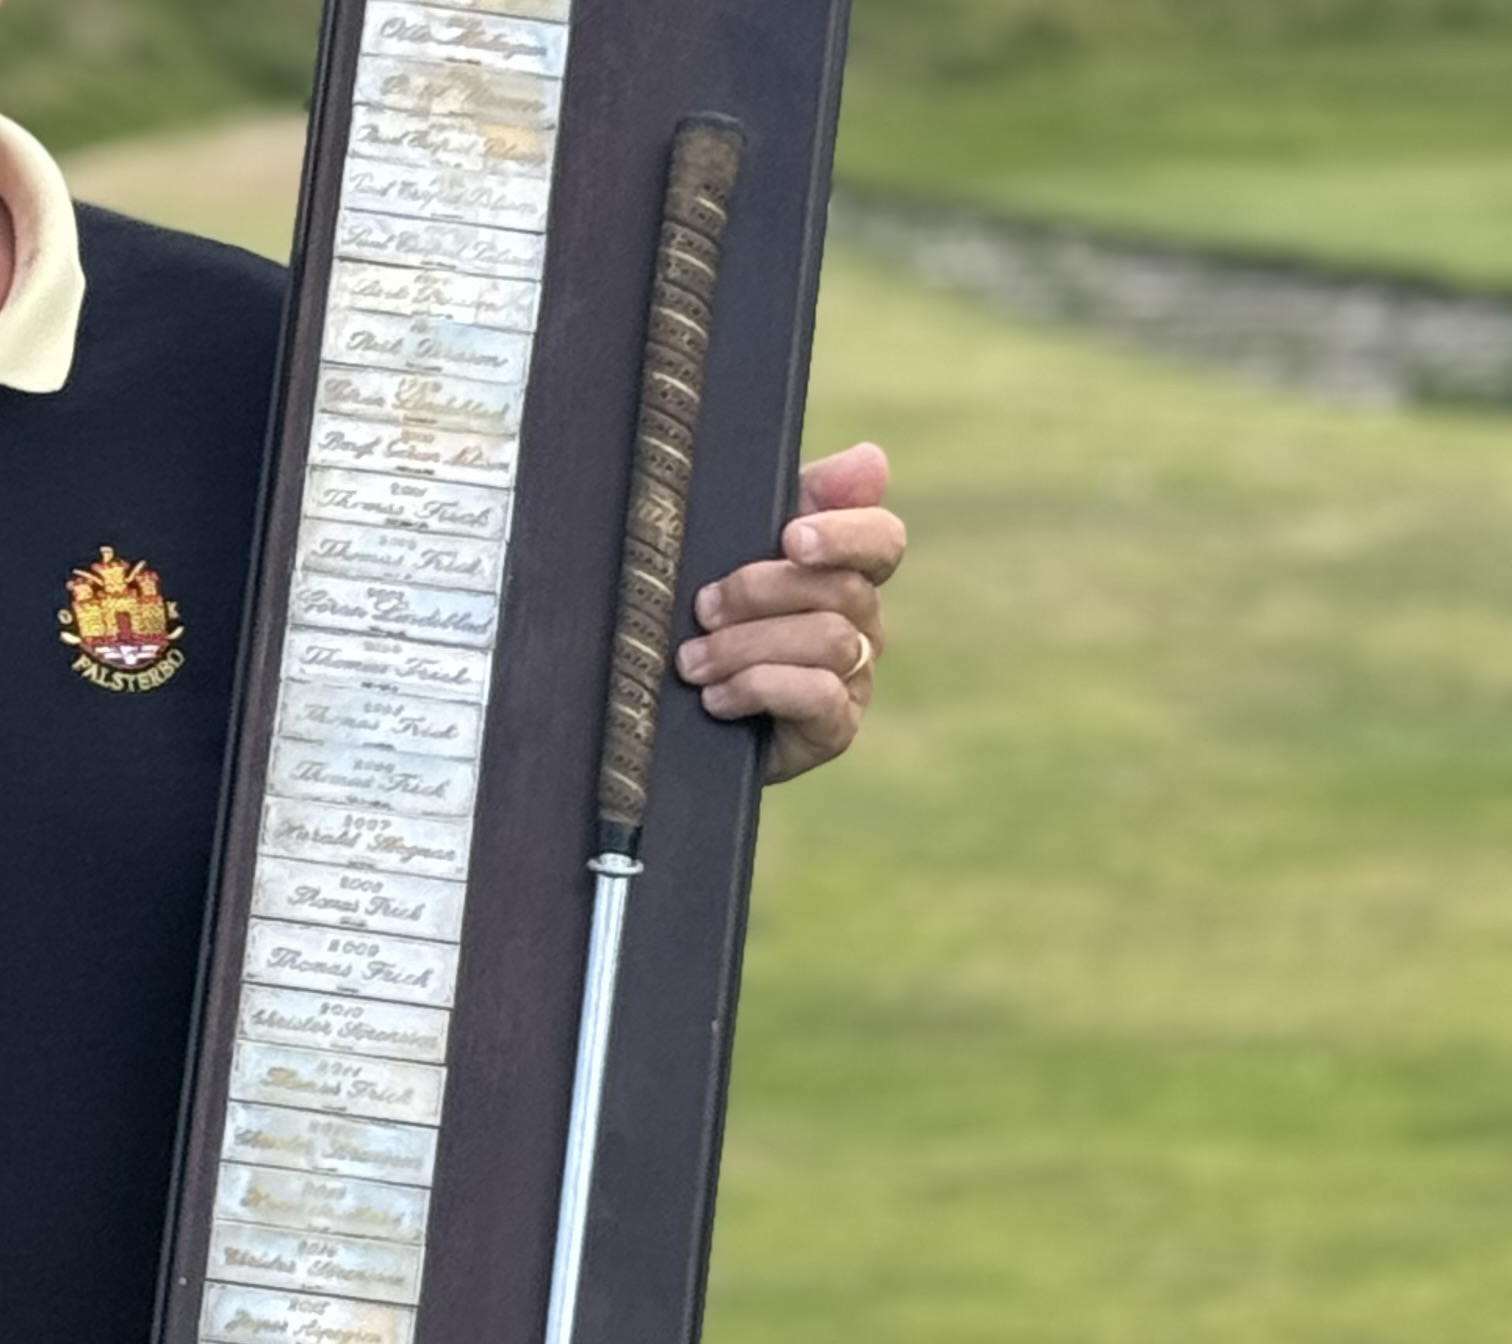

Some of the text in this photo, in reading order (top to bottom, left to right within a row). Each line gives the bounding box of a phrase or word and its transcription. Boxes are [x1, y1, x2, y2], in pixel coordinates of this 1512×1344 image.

[315, 488, 405, 516] Thomas
[310, 538, 404, 566] Thomas
[299, 644, 389, 674] Thomas
[295, 703, 380, 731] Thomas
[289, 760, 375, 788] Thomas
[343, 814, 392, 831] 2007
[287, 884, 360, 913] Thomas
[266, 946, 352, 978] Thomas
[319, 1001, 365, 1019] 2010
